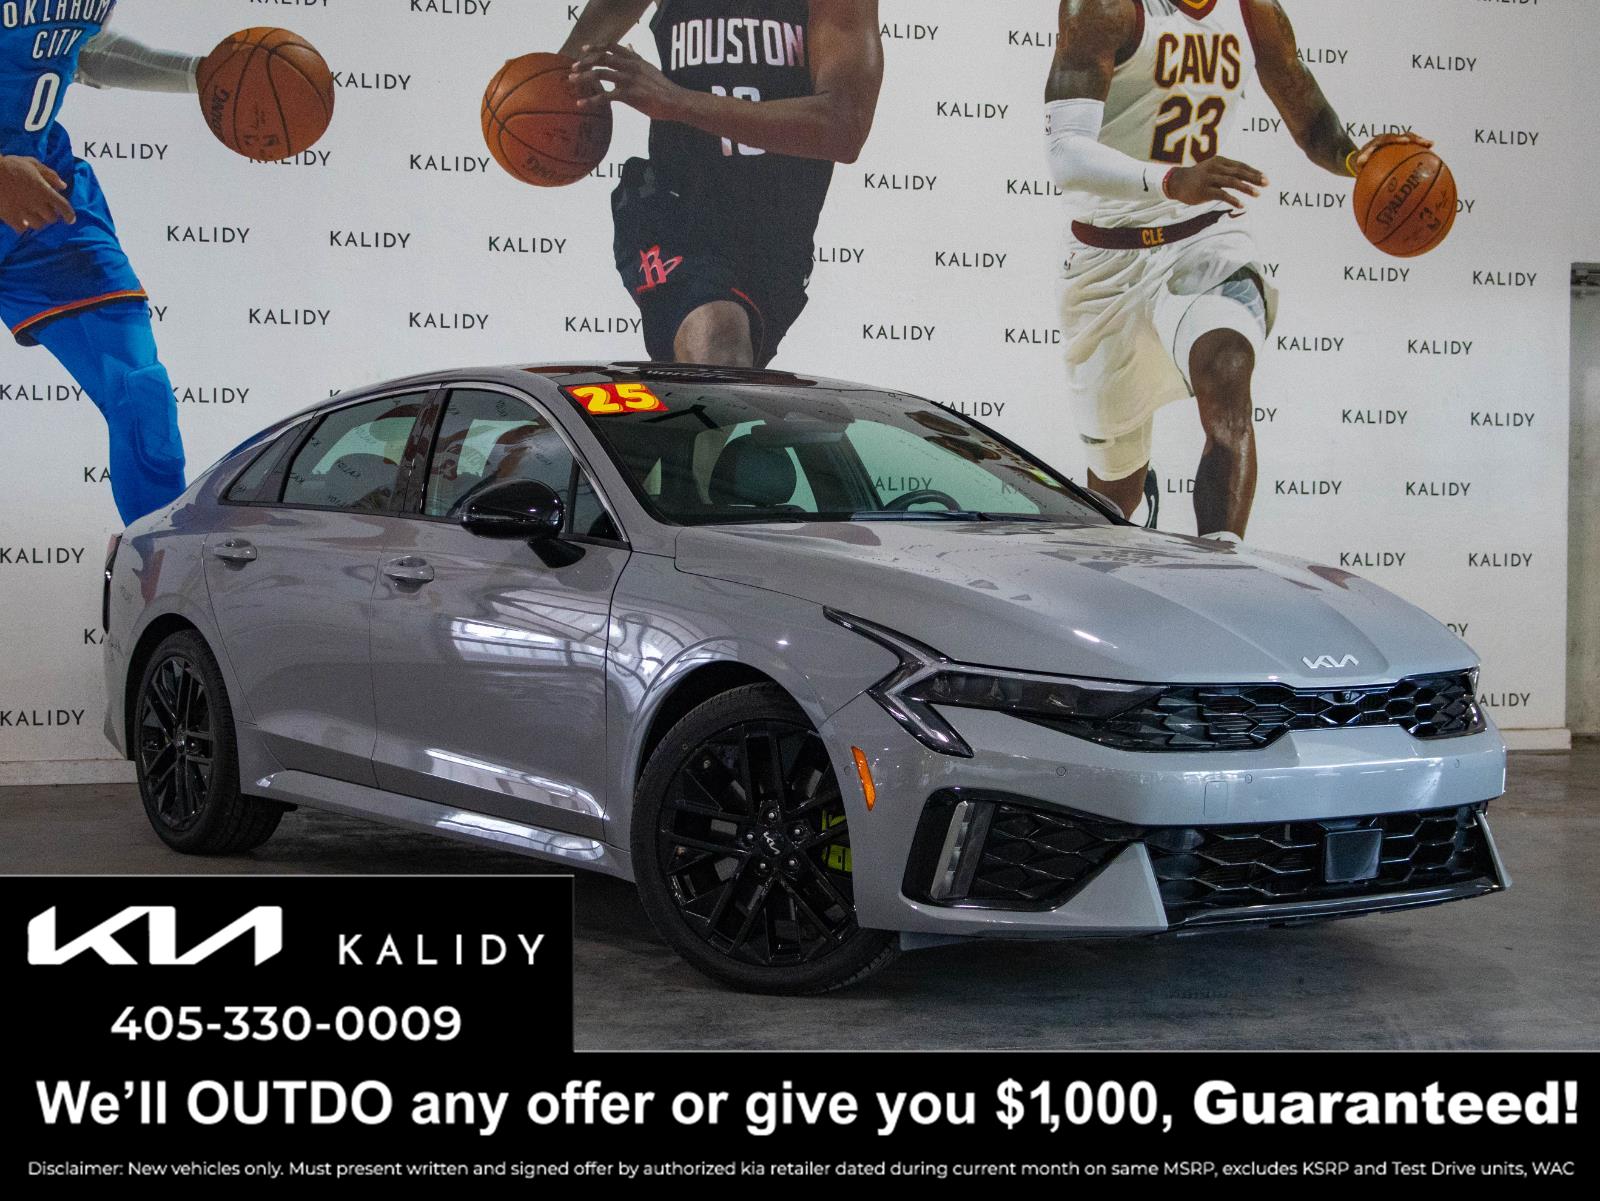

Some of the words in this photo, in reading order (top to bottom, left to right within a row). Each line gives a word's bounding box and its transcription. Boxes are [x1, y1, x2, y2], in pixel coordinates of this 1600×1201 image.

[410, 0, 491, 16] KALIDY
[880, 24, 939, 41] ALIDY
[1009, 30, 1060, 48] KALI
[32, 29, 82, 59] CITY
[670, 18, 804, 71] HOUSTON
[1153, 32, 1241, 90] CAVS
[1296, 48, 1348, 65] ALIDY
[1412, 54, 1476, 71] KALIDY
[333, 72, 411, 91] KALIDY
[24, 72, 60, 132] 0
[937, 101, 1008, 119] KALIDY
[1150, 95, 1226, 165] 23
[1475, 129, 1539, 146] KALIDY
[84, 142, 168, 160] KALIDY
[411, 154, 490, 172] KALIDY
[865, 173, 936, 190] KALIDY
[1007, 179, 1063, 196] KALID
[1280, 192, 1346, 208] KALIDY
[168, 226, 249, 243] KALIDY
[330, 231, 410, 248] KALIDY
[1141, 226, 1165, 246] CLE
[489, 236, 566, 254] KALIDY
[812, 247, 864, 264] LIDY
[936, 251, 1006, 268] KALIDY
[1344, 266, 1410, 282] KALIDY
[1473, 271, 1536, 286] KALIDY
[249, 308, 330, 325] KALIDY
[409, 312, 488, 329] KALIDY
[565, 316, 643, 333] KALIDY
[863, 324, 935, 341] KALIDY
[1005, 329, 1060, 344] KALID
[1278, 336, 1344, 351] KALIDY
[1408, 340, 1472, 355] KALIDY
[0, 384, 83, 401] KALIDY
[571, 383, 663, 413] 25
[1342, 409, 1407, 424] KALIDY
[1471, 412, 1534, 427] KALIDY
[1275, 480, 1342, 495] KALIDY
[1406, 482, 1471, 496] KALIDY
[0, 548, 85, 563] KALIDY
[1340, 553, 1406, 567] KALIDY
[1469, 553, 1532, 567] KALIDY
[1480, 693, 1531, 707] ALIDY
[0, 710, 84, 726] KALIDY
